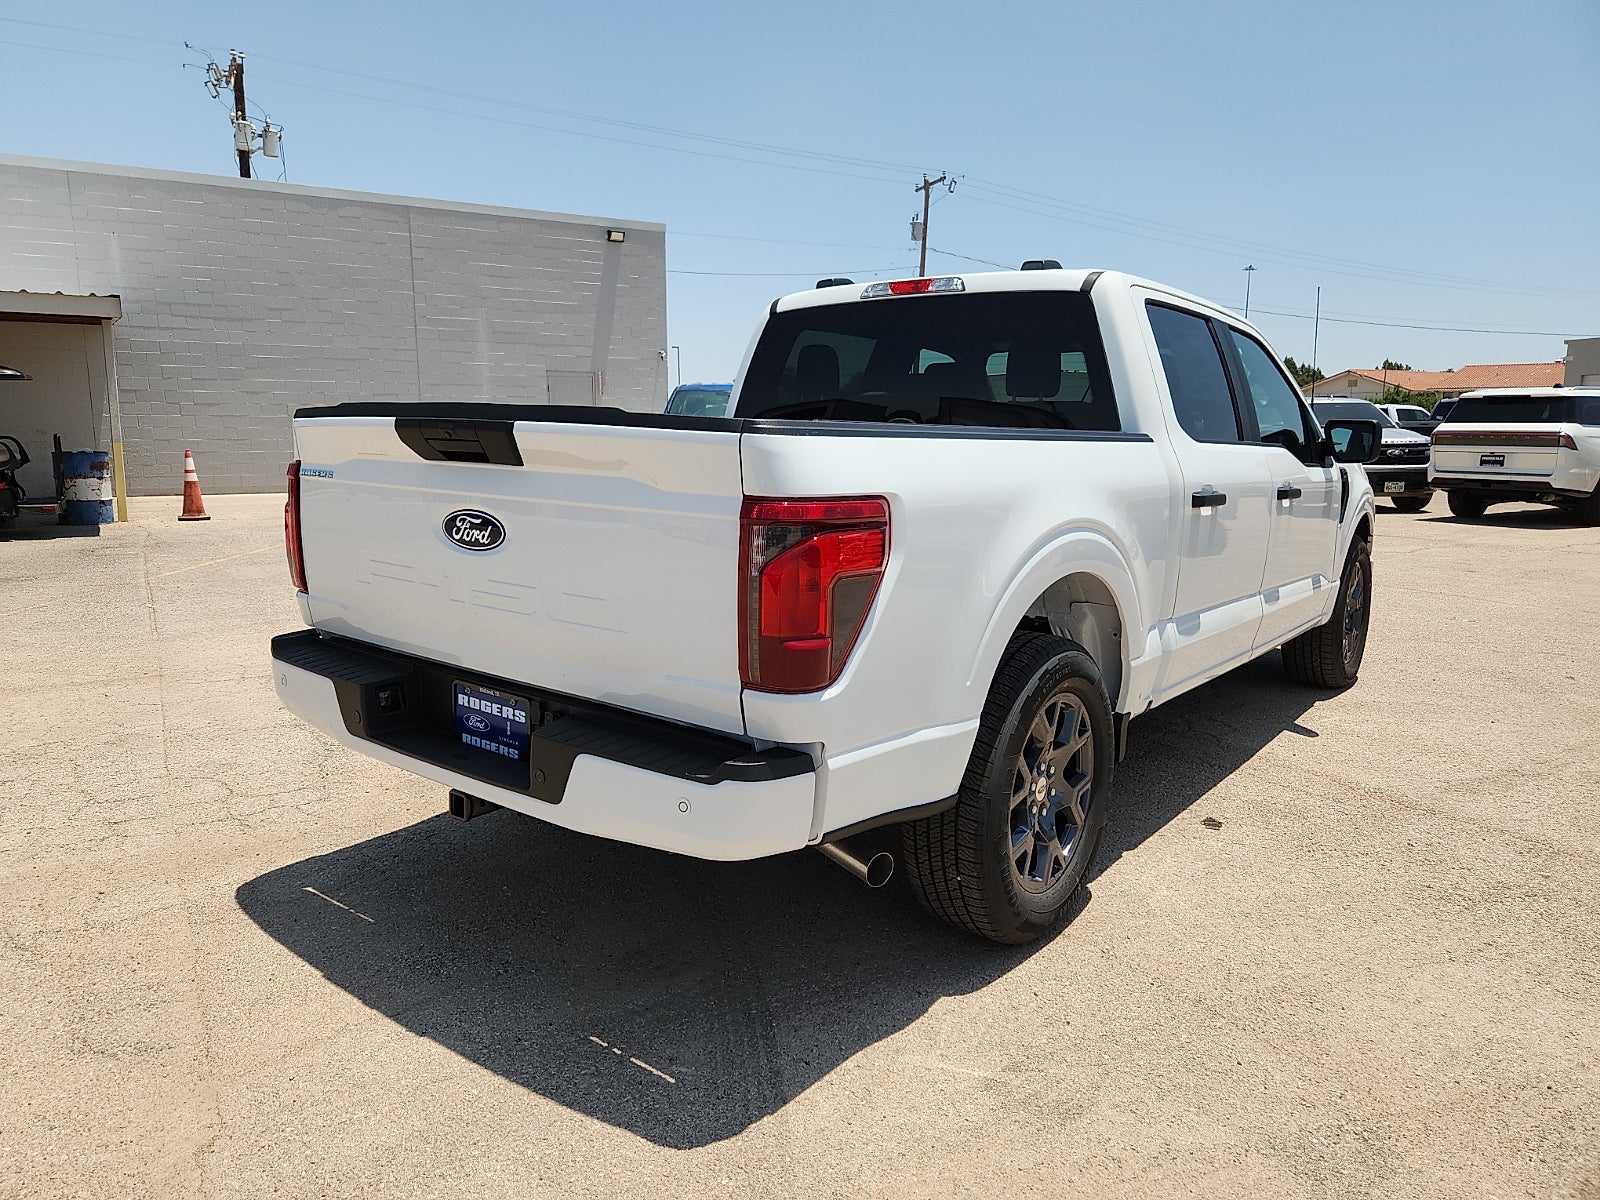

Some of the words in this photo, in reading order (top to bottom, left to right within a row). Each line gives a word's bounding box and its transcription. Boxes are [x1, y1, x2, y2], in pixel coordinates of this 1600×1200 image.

[452, 515, 492, 545] Ford
[458, 694, 526, 723] ROGERS
[468, 715, 486, 730] Ford
[462, 733, 519, 759] ROGERS
